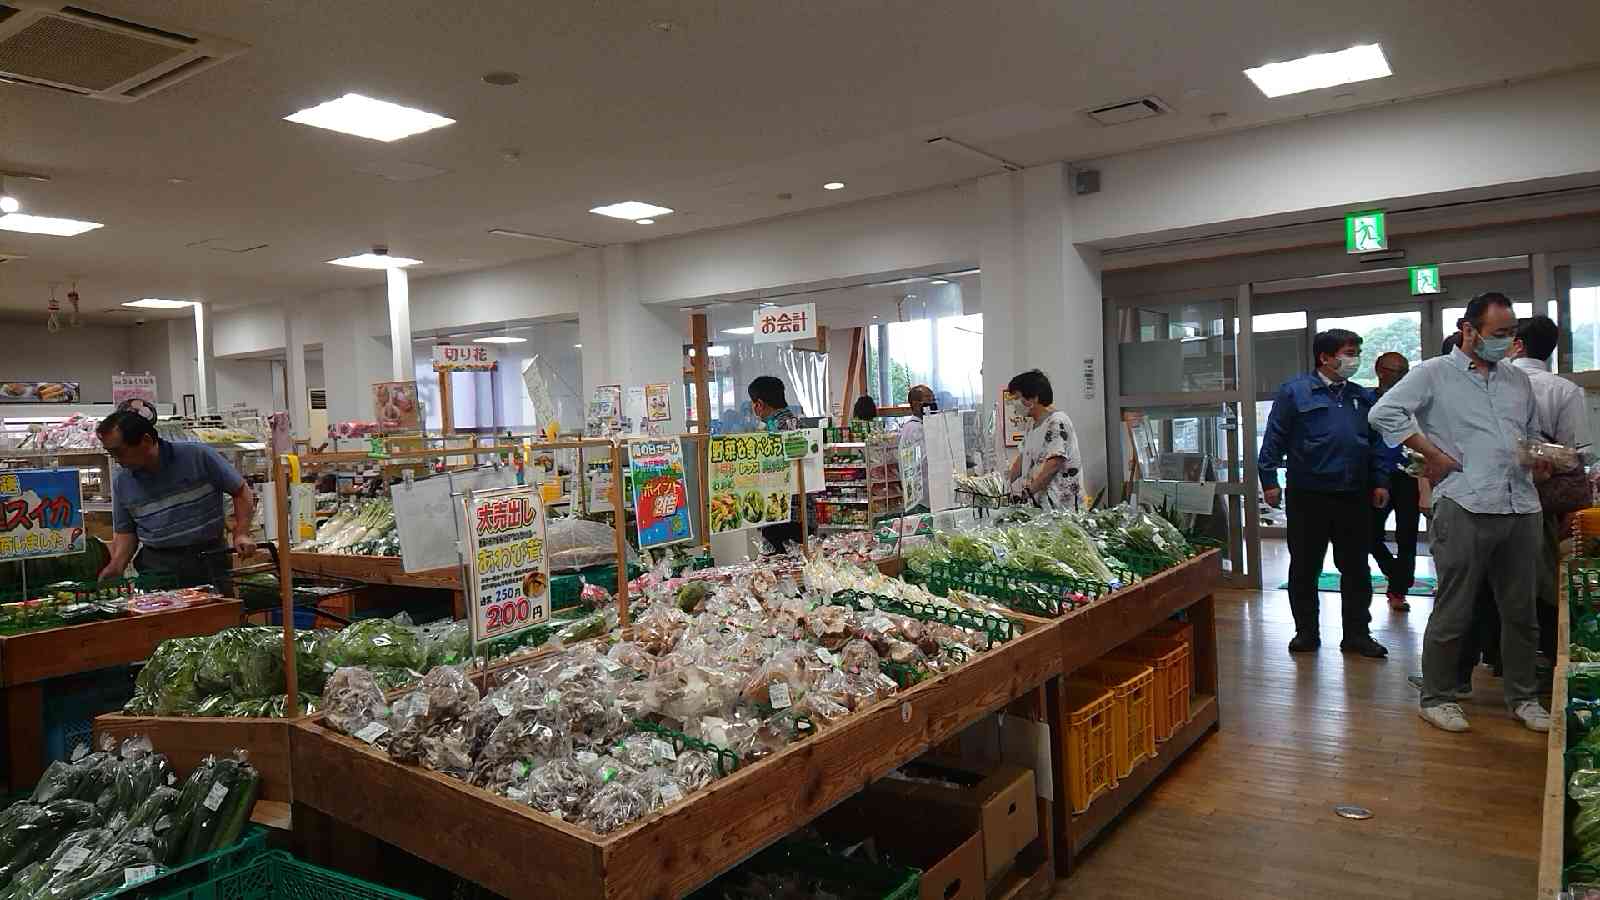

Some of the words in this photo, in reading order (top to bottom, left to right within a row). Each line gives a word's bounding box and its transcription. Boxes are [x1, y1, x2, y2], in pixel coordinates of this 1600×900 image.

[761, 311, 808, 334] お会計
[444, 347, 488, 361] 切り花
[711, 437, 784, 463] 野菜を食べよう
[641, 481, 681, 498] ポイント
[477, 498, 536, 535] 大売出し
[478, 538, 543, 574] あわび茸
[485, 596, 542, 632] 200円
